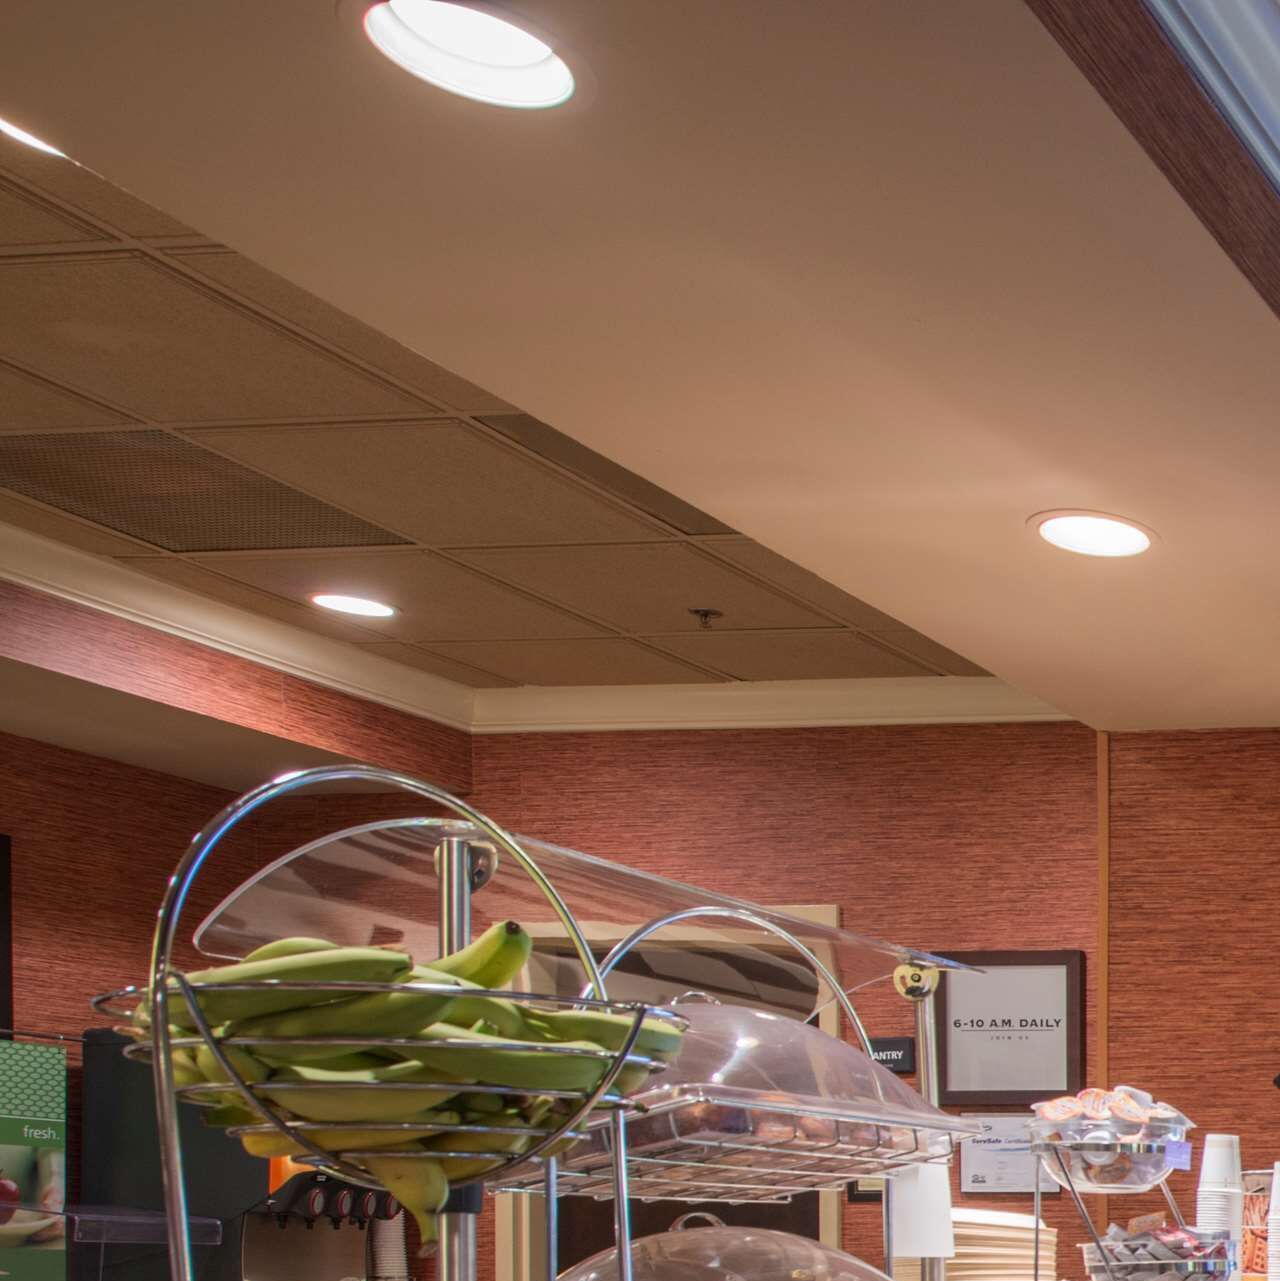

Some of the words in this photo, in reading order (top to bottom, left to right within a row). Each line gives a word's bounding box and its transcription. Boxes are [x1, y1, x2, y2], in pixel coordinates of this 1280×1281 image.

[953, 1018, 985, 1029] 6-10
[1019, 1018, 1062, 1028] DAILY
[871, 1050, 904, 1061] ANTRY
[23, 1124, 61, 1139] fresh.
